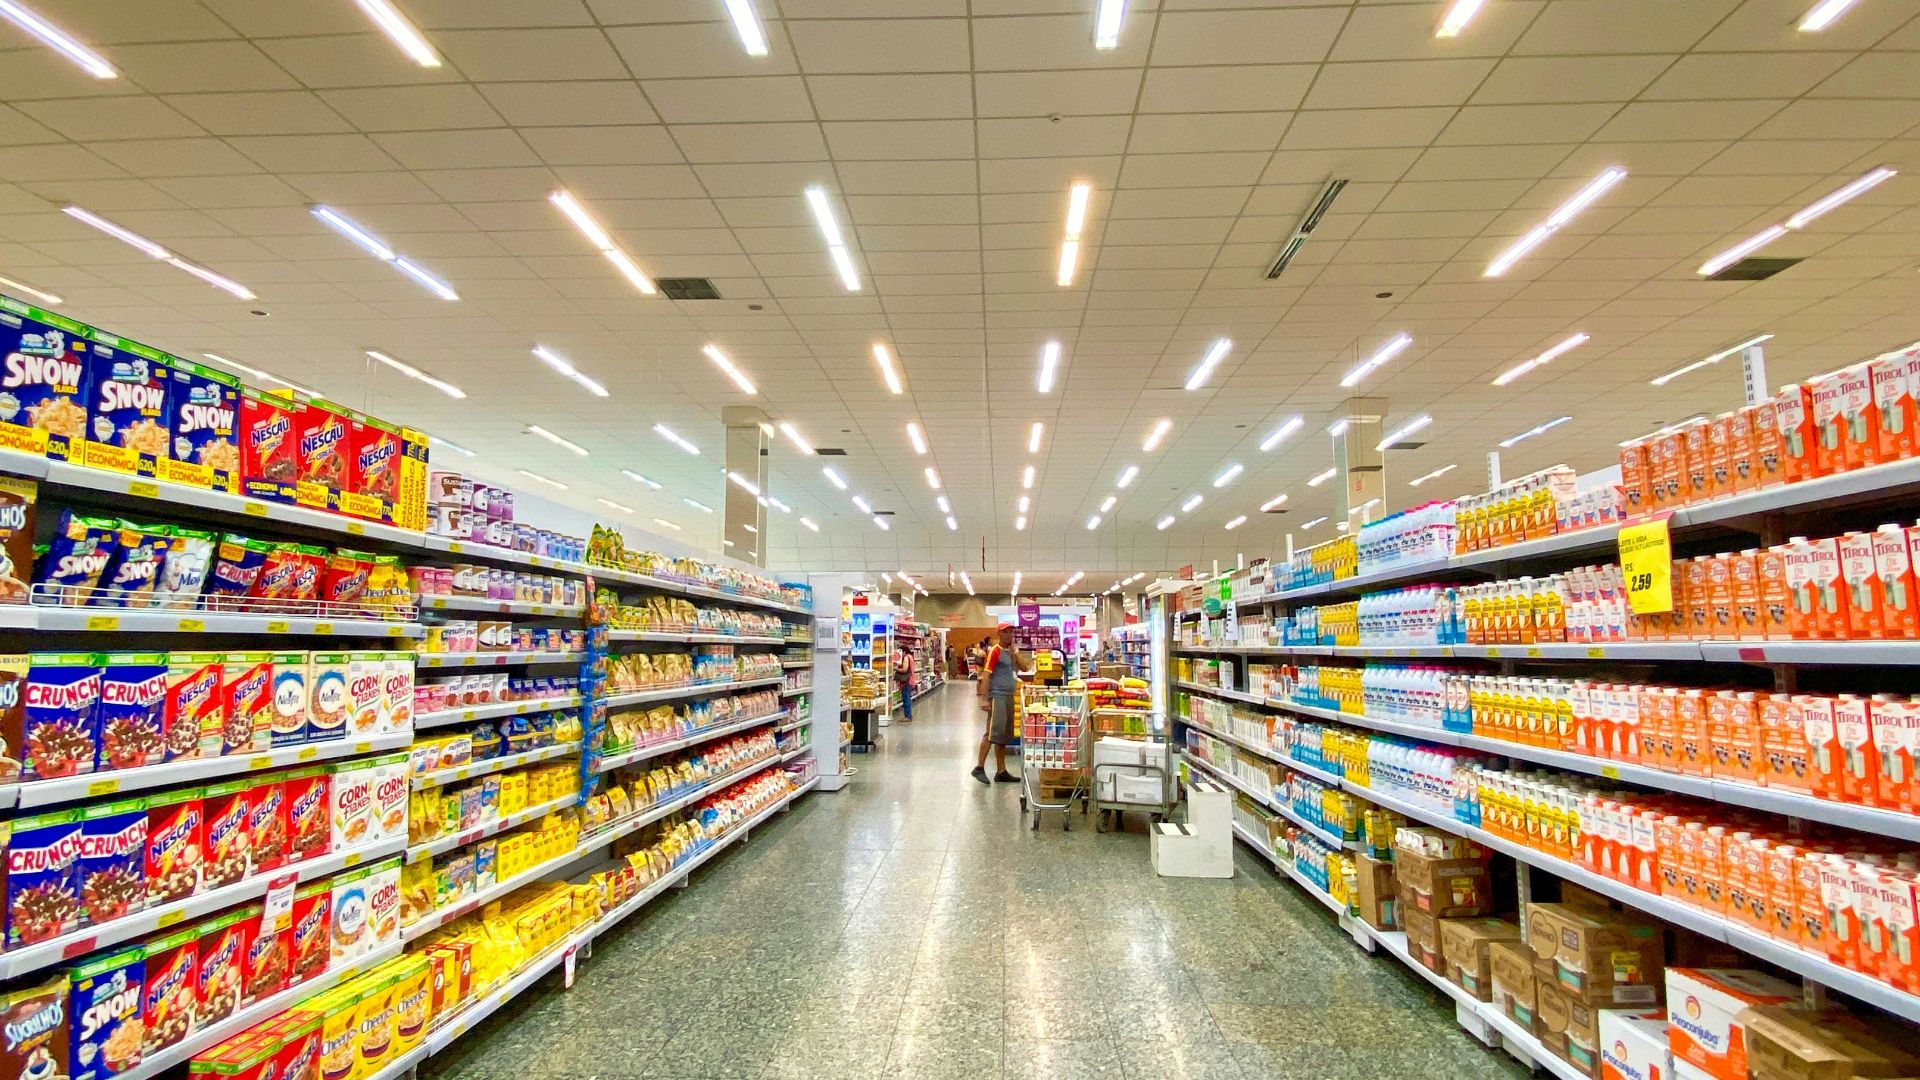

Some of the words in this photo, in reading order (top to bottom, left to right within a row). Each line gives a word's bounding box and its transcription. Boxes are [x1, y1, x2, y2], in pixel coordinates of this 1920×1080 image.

[3, 353, 82, 388] SNOW
[1875, 368, 1904, 384] TIROL
[100, 381, 164, 412] SNOW
[1814, 390, 1838, 404] TIROL
[1840, 380, 1867, 395] TIROL
[180, 404, 234, 433] SNOW
[1776, 400, 1801, 414] TIROL
[0, 423, 31, 437] BALAGEM
[252, 418, 289, 446] NESCAU
[302, 424, 343, 455] NESCAU
[0, 434, 45, 453] ONÔMICA
[48, 440, 69, 458] 620g
[88, 454, 136, 471] ECONÔMICA
[138, 458, 156, 475] 620g
[359, 442, 395, 471] NESCAU
[169, 470, 211, 486] ECONÔMICA
[1, 505, 26, 530] HOS
[1785, 554, 1809, 565] TIROL
[1810, 551, 1836, 562] TIROL
[1842, 547, 1872, 559] TIROL
[1875, 543, 1904, 555] TIROL
[52, 553, 110, 578] SNOW
[216, 562, 260, 585] CRUNC
[261, 563, 294, 588] NESCAU
[334, 571, 367, 595] NESCAU
[1631, 573, 1652, 592] 2,59
[26, 677, 99, 707] CRUNCH
[103, 675, 167, 704] CRUNCH
[178, 673, 217, 708] NESCAU
[234, 670, 268, 704] NESCAU
[351, 674, 378, 697] CORN
[386, 673, 410, 695] CORN
[1805, 710, 1831, 723] TIROL
[1837, 711, 1864, 725] TIROL
[1873, 713, 1903, 728] TIROL
[1904, 715, 1920, 729] TIR
[338, 782, 368, 809] CORN
[377, 775, 404, 800] CORN
[291, 782, 325, 822] NESCAU
[151, 811, 199, 861] NESCAU
[210, 801, 248, 848] NESCAU
[81, 822, 148, 857] CRUNCH
[10, 833, 82, 872] CRUNCH
[1821, 871, 1848, 889] TIROL
[1851, 880, 1880, 898] TIROL
[371, 882, 396, 908] CORN
[1880, 889, 1910, 909] TIROL
[294, 900, 328, 943] NESCAU
[200, 933, 238, 986] NESCAU
[148, 951, 194, 1010] NESCAU
[80, 985, 140, 1041] SNOW
[398, 989, 428, 1014] Cheerios
[361, 1008, 394, 1033] Cheerios
[1671, 1011, 1719, 1045] Piracanjuba
[321, 1029, 357, 1056] Cheerios
